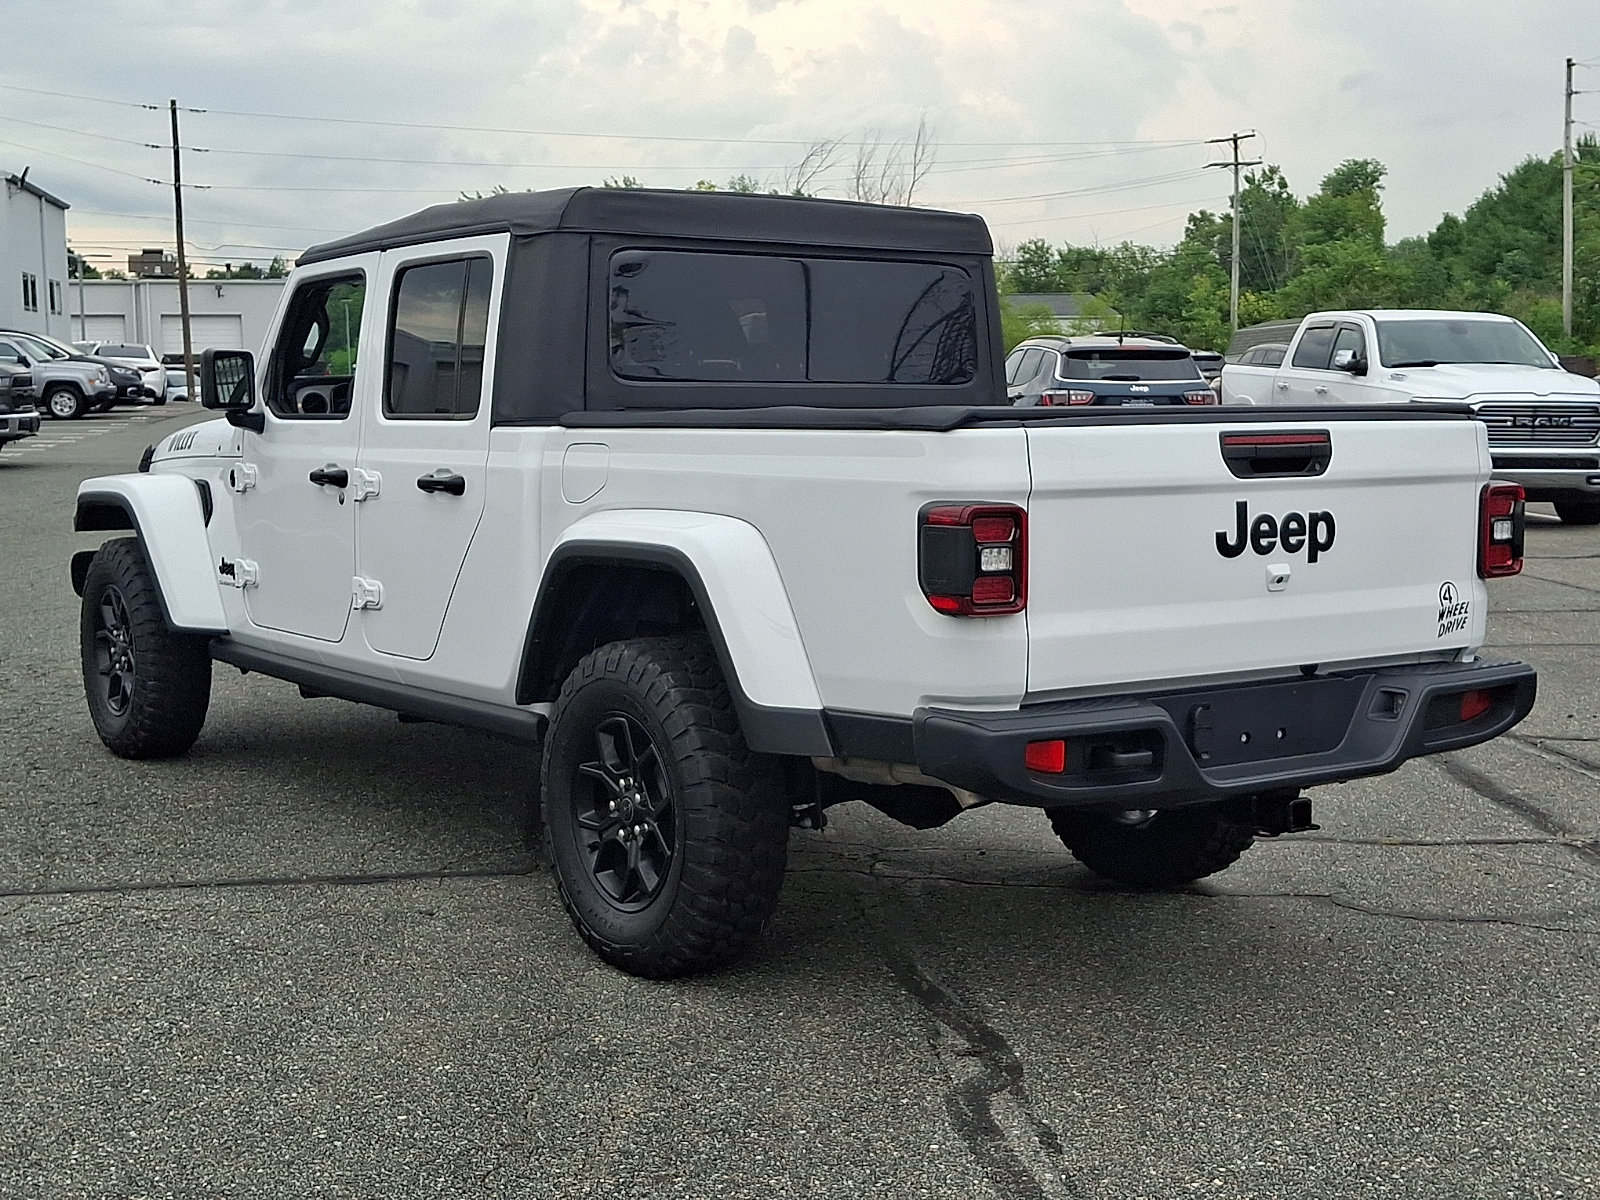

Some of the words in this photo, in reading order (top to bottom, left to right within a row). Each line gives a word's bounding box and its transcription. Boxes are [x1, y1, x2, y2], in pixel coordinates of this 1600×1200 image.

[1515, 417, 1570, 426] RAM
[1216, 500, 1335, 563] Jeep
[1442, 584, 1452, 604] 4
[1438, 601, 1469, 622] WHEEL
[1438, 616, 1468, 638] DRIVE
